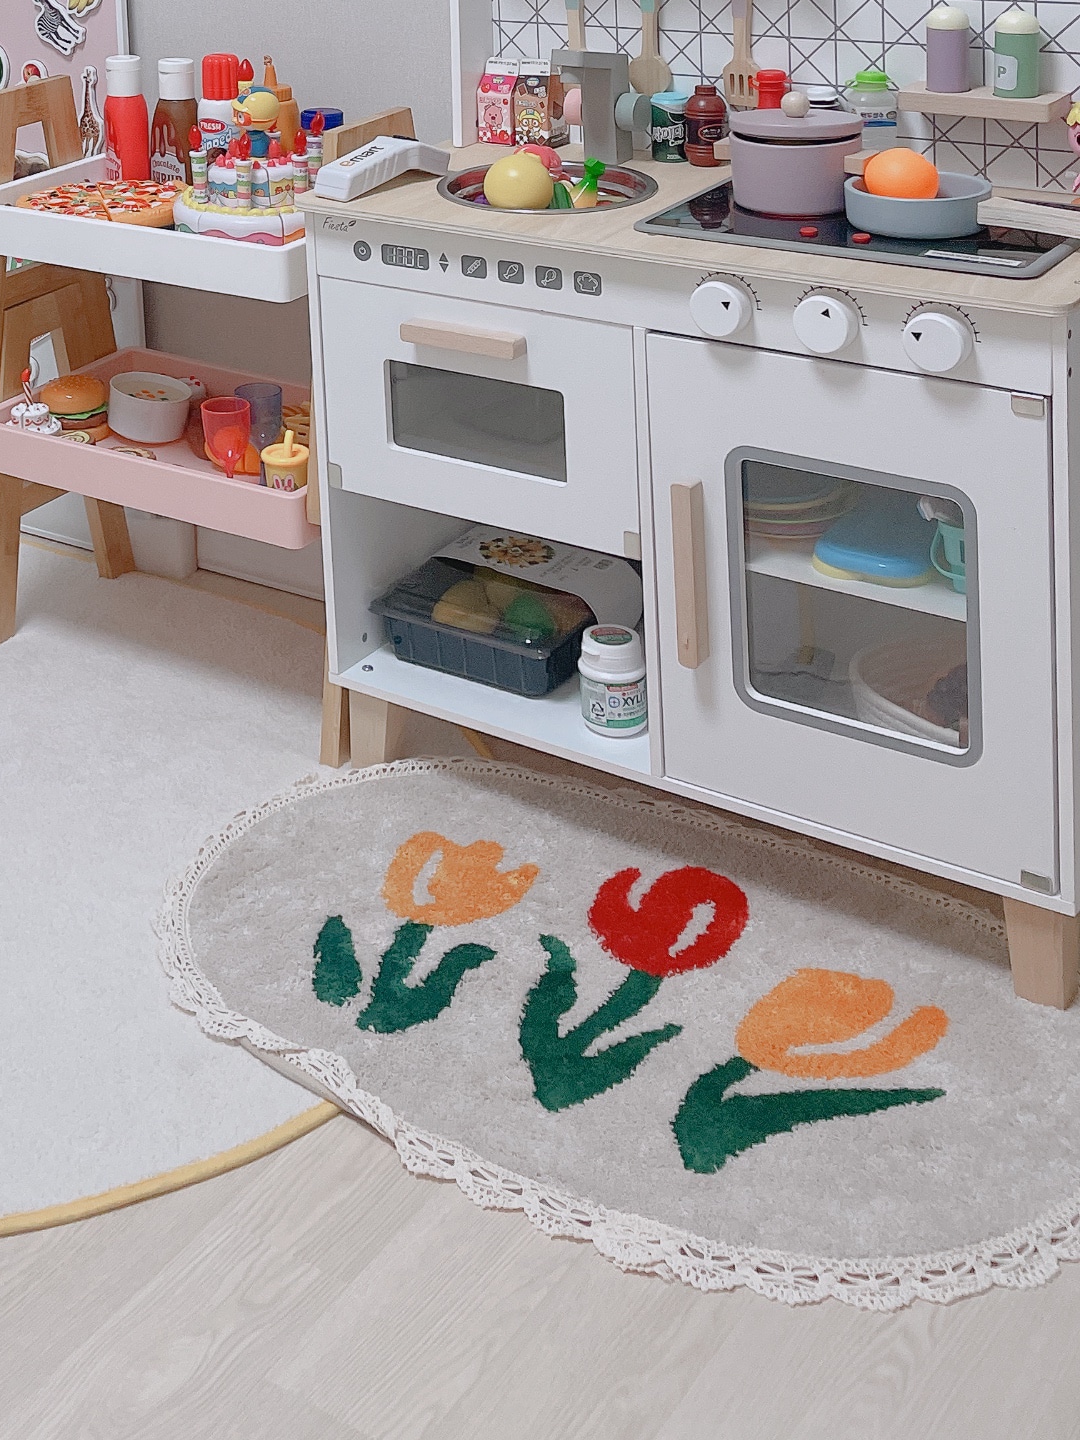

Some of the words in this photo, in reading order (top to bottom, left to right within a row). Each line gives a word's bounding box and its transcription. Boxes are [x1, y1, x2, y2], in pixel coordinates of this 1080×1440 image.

[200, 121, 222, 131] FRESH
[339, 146, 385, 167] emart
[322, 216, 349, 233] Fiesta
